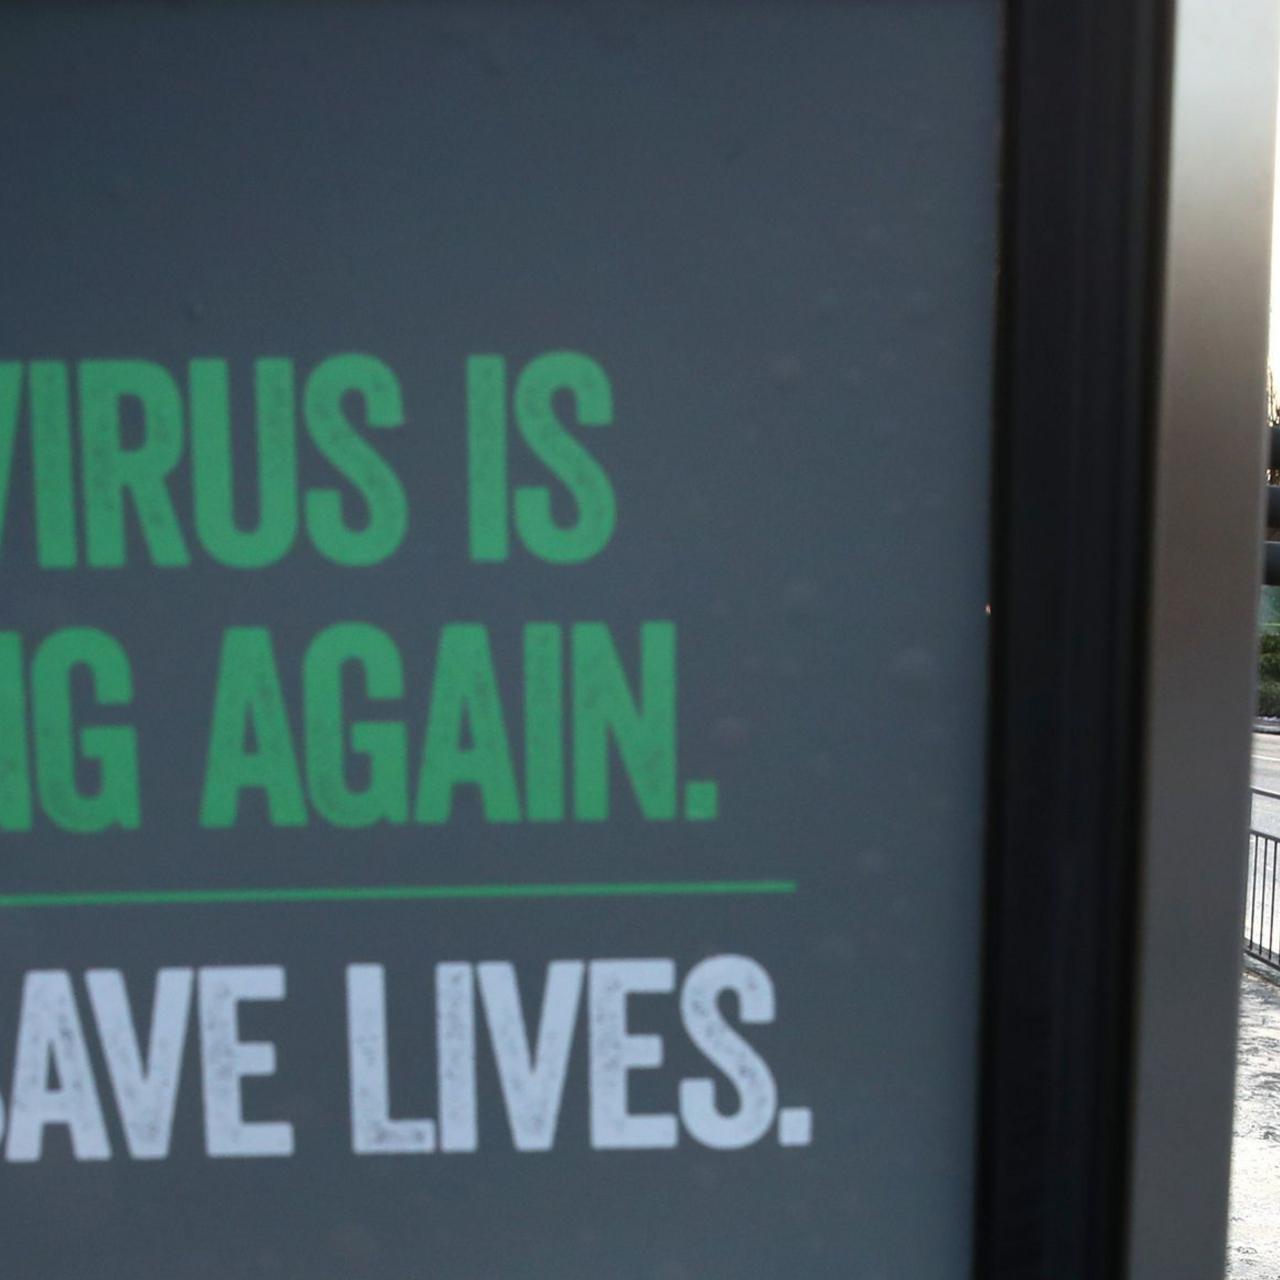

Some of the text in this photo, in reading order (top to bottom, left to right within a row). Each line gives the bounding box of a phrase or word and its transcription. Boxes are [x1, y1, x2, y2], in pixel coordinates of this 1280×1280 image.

[465, 351, 617, 565] IS
[199, 619, 719, 829] AGAIN.
[345, 953, 813, 1156] LIVES.
